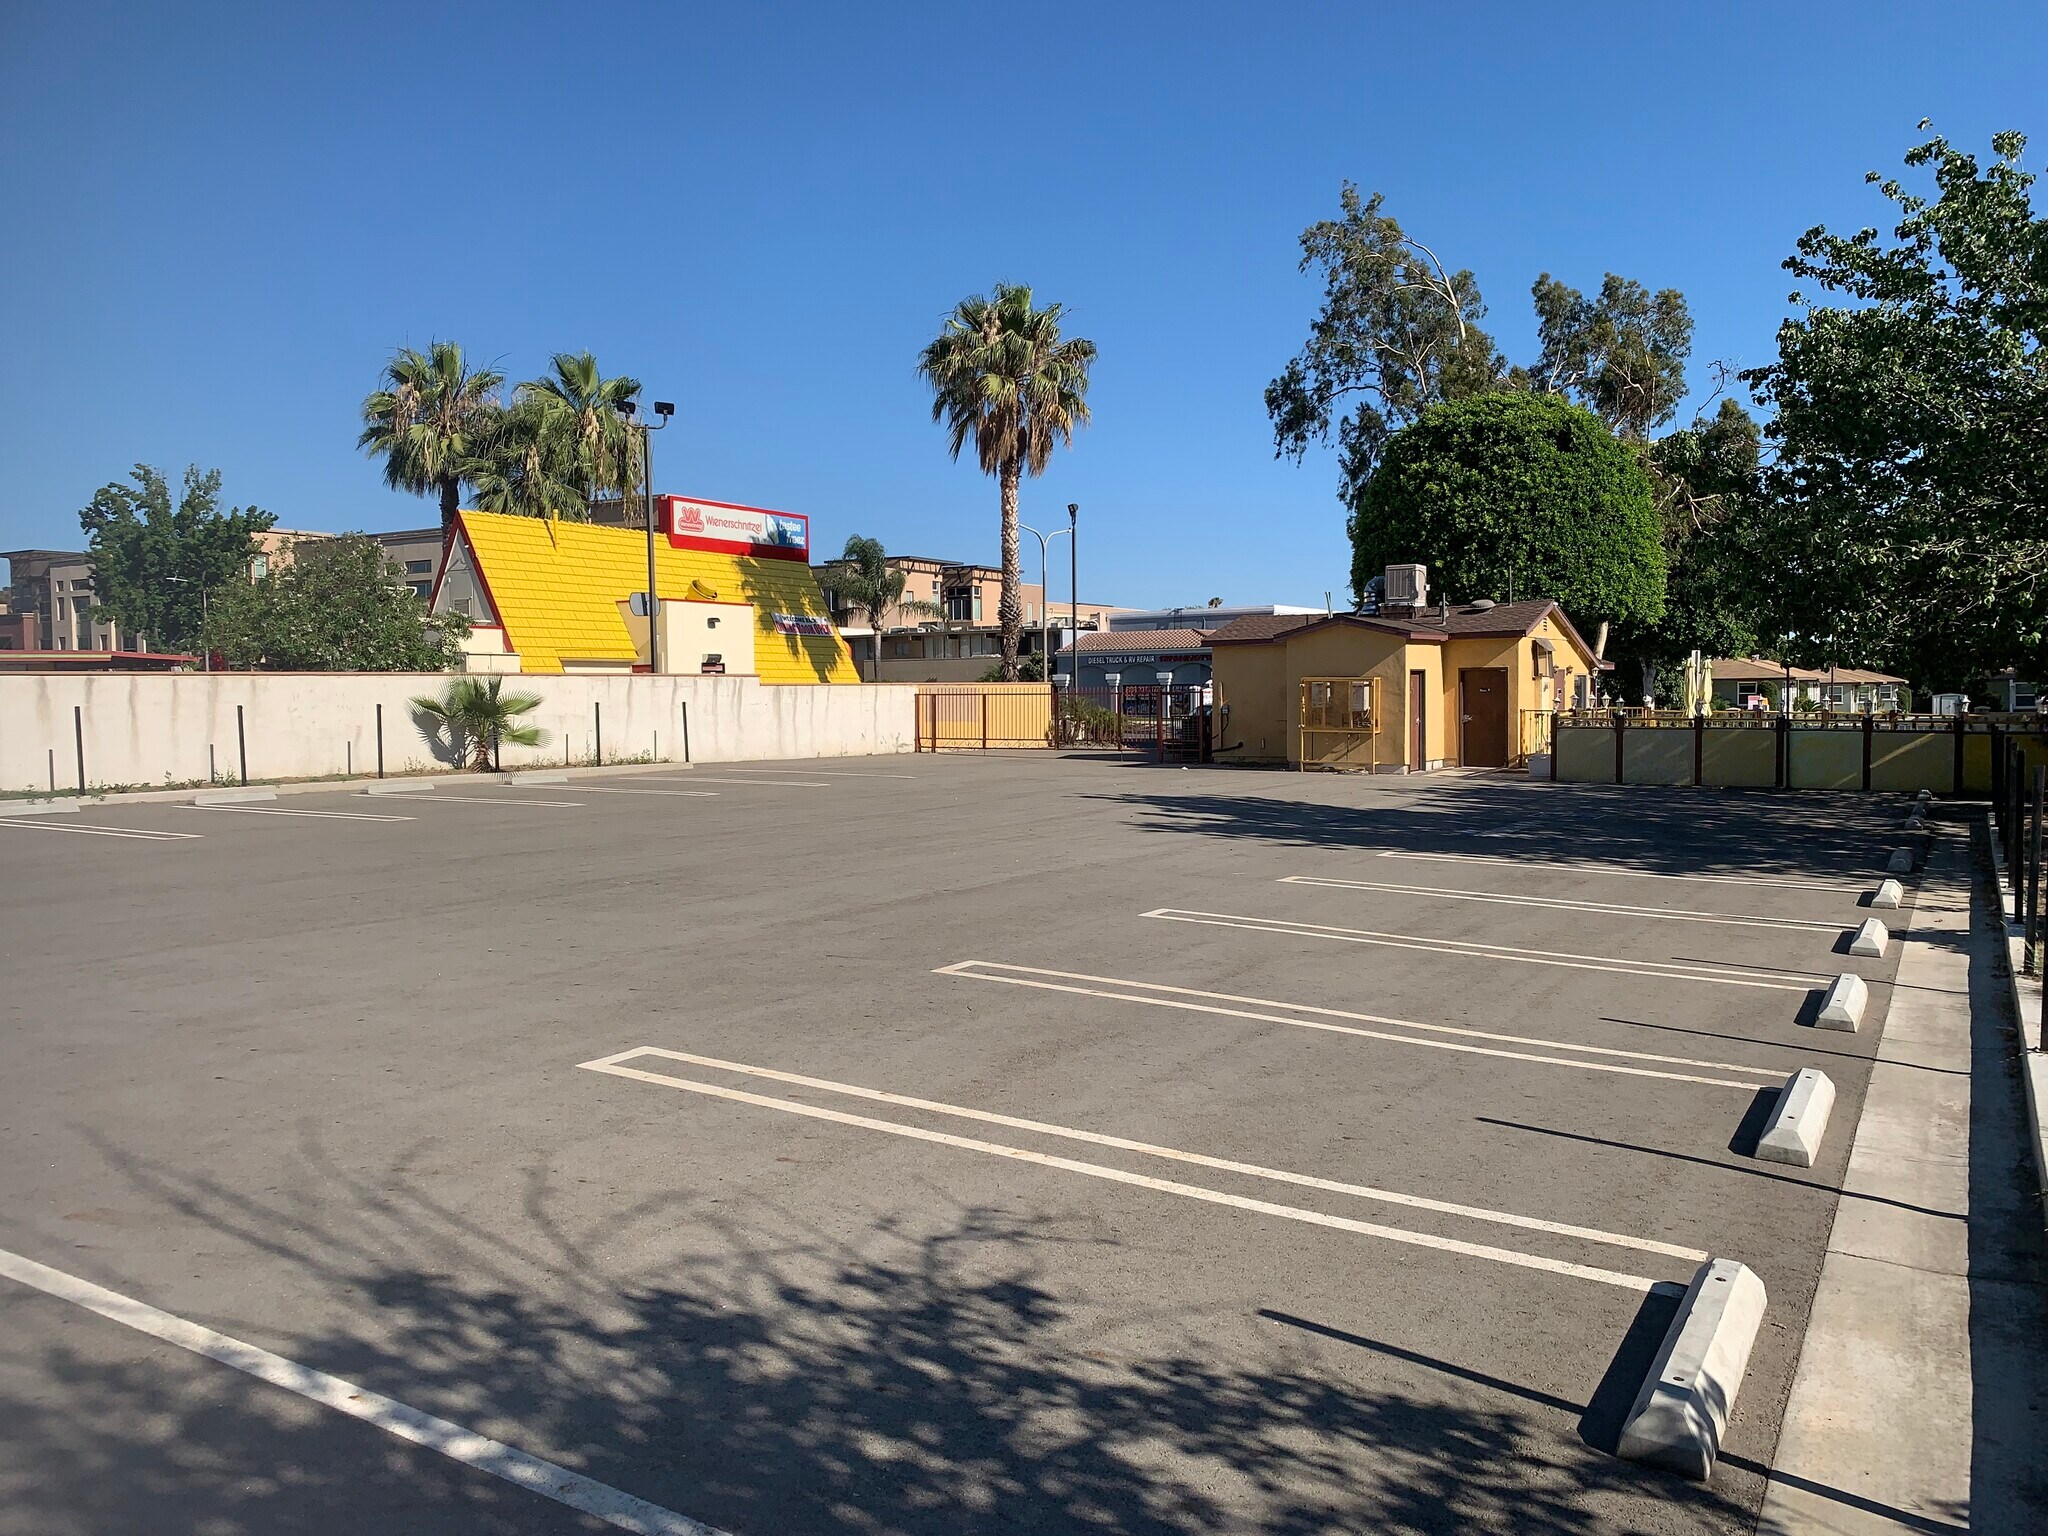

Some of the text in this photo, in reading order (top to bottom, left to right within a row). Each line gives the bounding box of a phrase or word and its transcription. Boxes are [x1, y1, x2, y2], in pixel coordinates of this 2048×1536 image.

[704, 515, 762, 534] Wienerschnitzel
[779, 519, 802, 532] tastee
[786, 531, 805, 544] freez
[1088, 656, 1105, 664] DIESEL
[1106, 656, 1123, 664] TRUCK
[1128, 655, 1136, 663] RV
[1136, 655, 1156, 663] REPAIR
